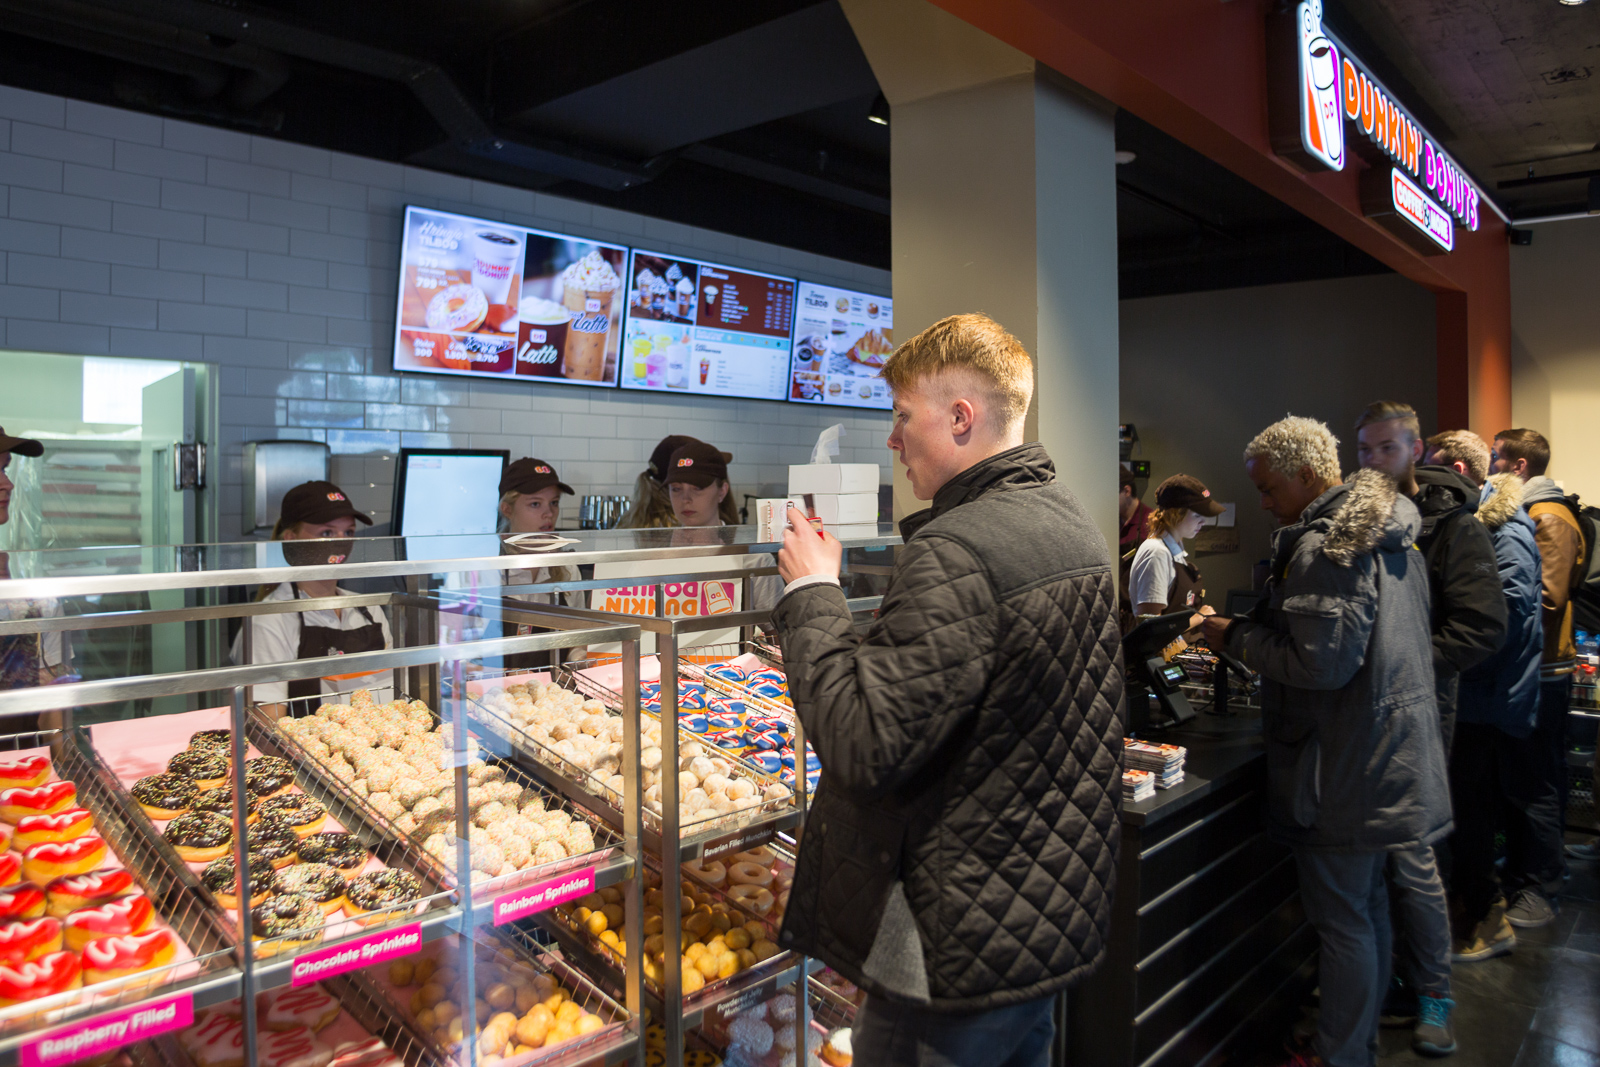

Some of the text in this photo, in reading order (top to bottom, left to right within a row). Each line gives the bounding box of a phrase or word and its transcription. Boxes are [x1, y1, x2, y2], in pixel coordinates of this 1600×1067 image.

[1343, 57, 1478, 231] DUNKIN' DONUTS
[573, 313, 609, 333] Latte
[518, 341, 558, 364] Latte
[677, 457, 694, 467] DD
[704, 842, 729, 858] Bavarian
[728, 836, 745, 849] Filled
[500, 877, 590, 915] Rainbow Sprinkles
[295, 931, 420, 977] Chocolate Sprinkles
[39, 1002, 177, 1058] Raspberry Filled
